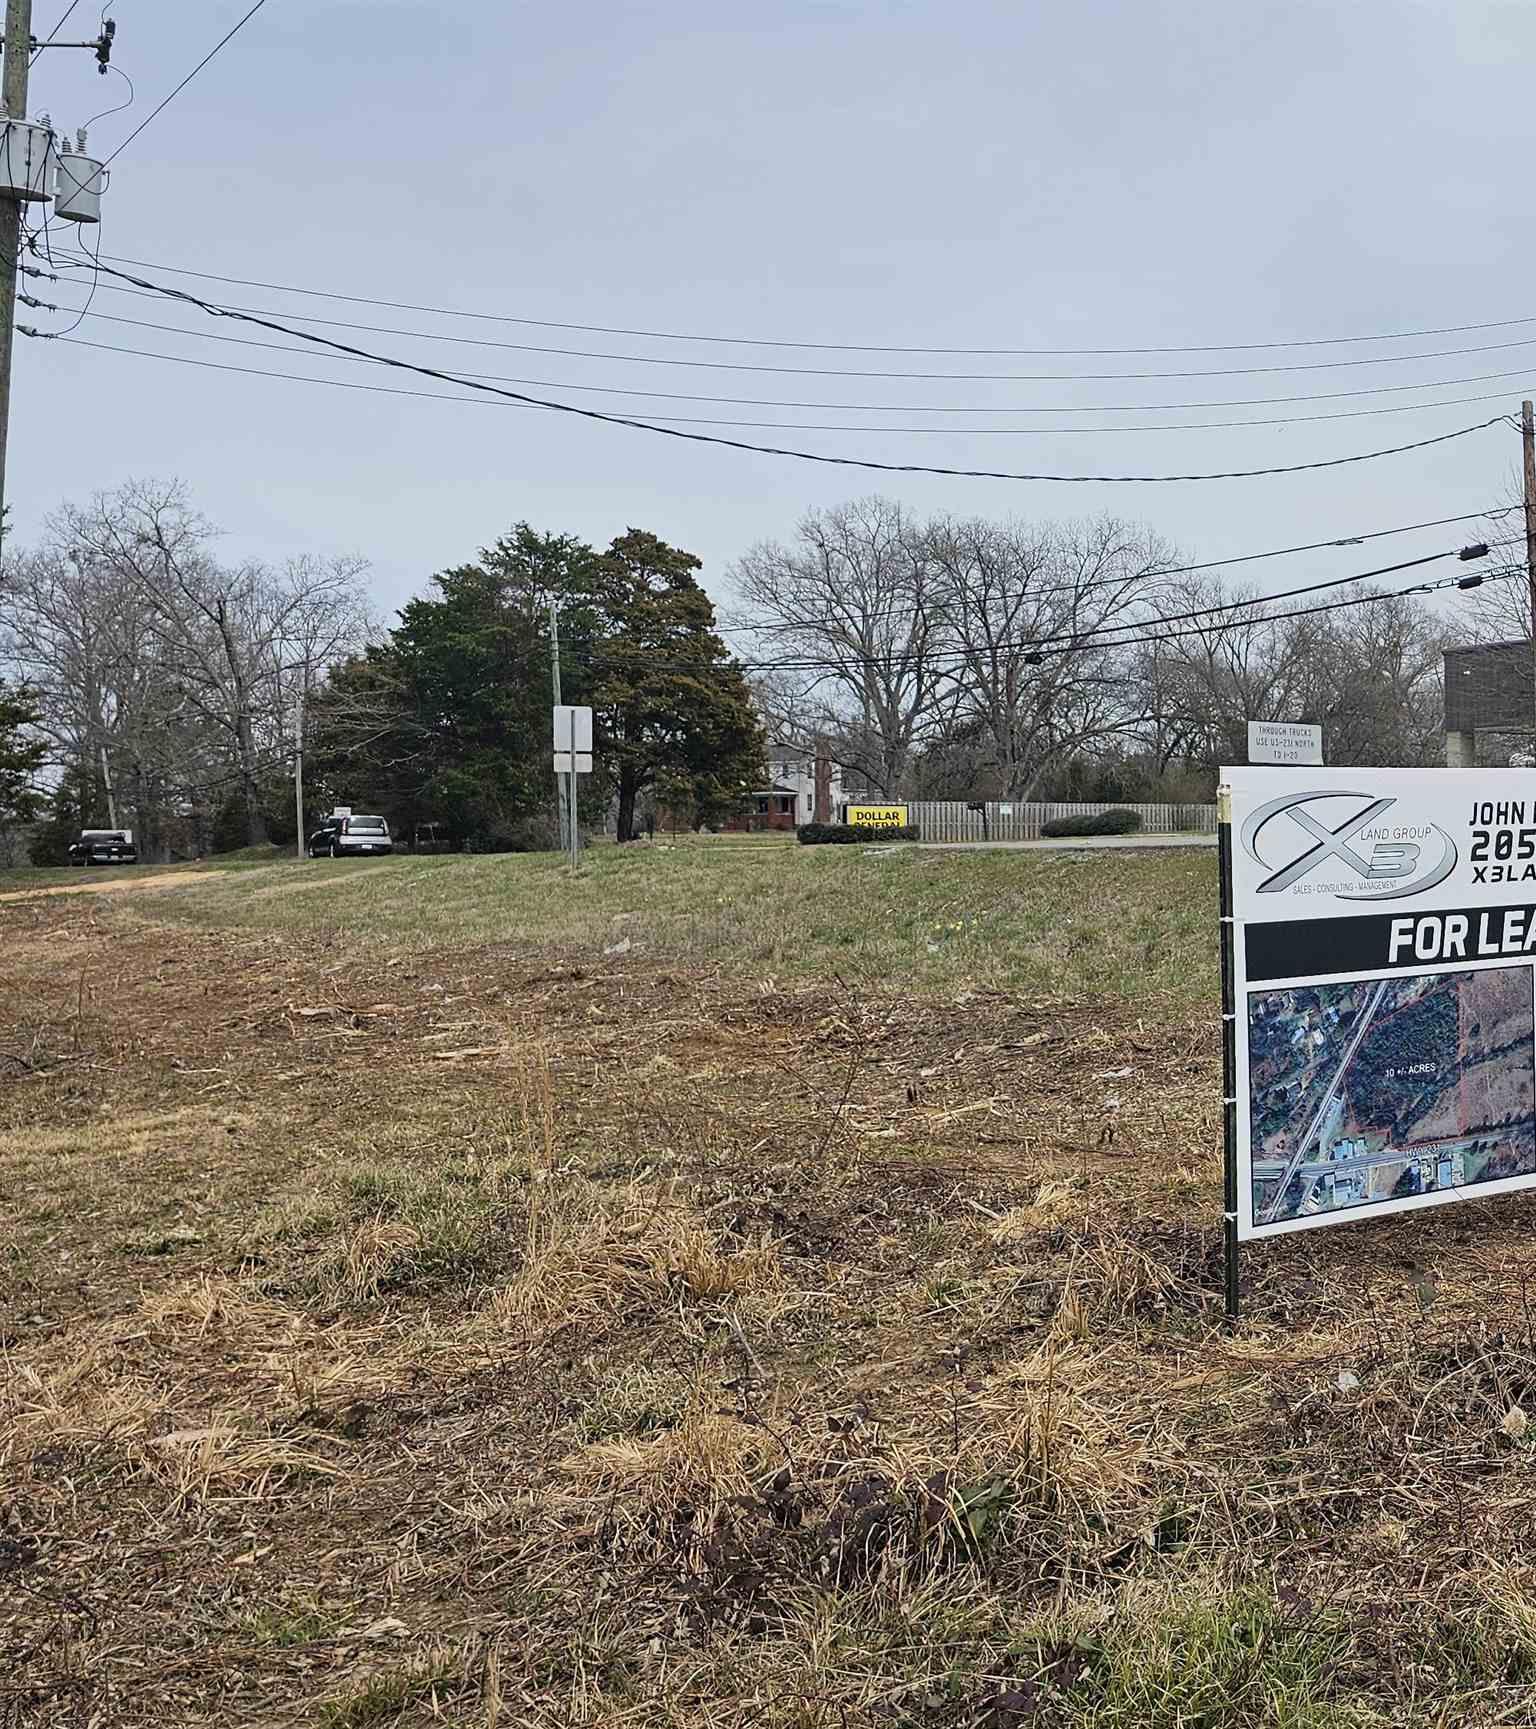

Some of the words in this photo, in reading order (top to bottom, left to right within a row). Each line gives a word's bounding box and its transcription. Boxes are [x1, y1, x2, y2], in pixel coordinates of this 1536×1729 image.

[1258, 726, 1287, 737] THROUGH
[1289, 727, 1312, 737] TRUCKS
[1256, 737, 1268, 746] USE
[856, 811, 900, 821] DOLLAR
[1469, 801, 1525, 826] JOHN
[1360, 828, 1390, 841] LAND
[1393, 826, 1432, 839] GROUP
[1293, 884, 1312, 895] SALES
[1317, 881, 1353, 893] CONSULTING
[1358, 879, 1397, 890] MANAGEMENT
[1388, 915, 1469, 963] FOR
[1385, 1068, 1395, 1078] 10
[1408, 1062, 1436, 1074] ACRES
